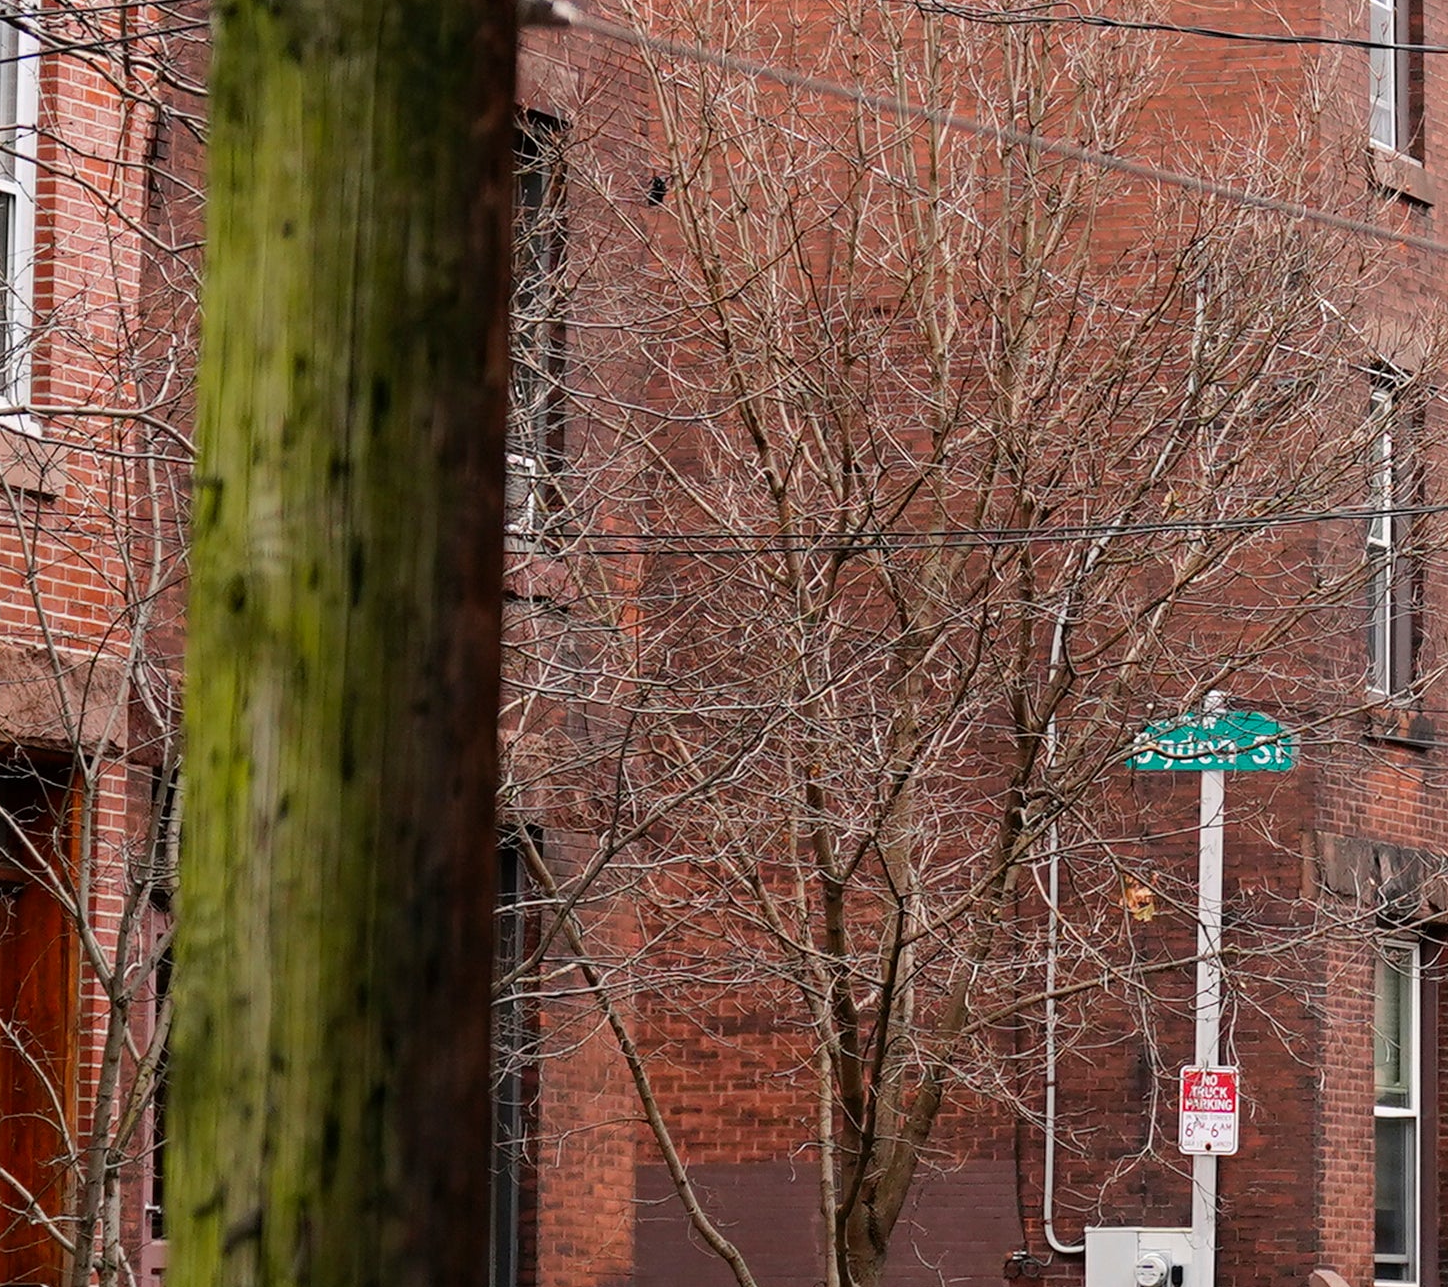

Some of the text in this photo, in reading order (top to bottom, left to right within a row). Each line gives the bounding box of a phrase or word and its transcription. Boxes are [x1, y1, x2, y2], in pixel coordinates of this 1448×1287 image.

[1252, 735, 1285, 764] St
[1202, 1073, 1218, 1086] NO
[1190, 1086, 1229, 1099] TRUCK
[1185, 1099, 1233, 1111] PARKING
